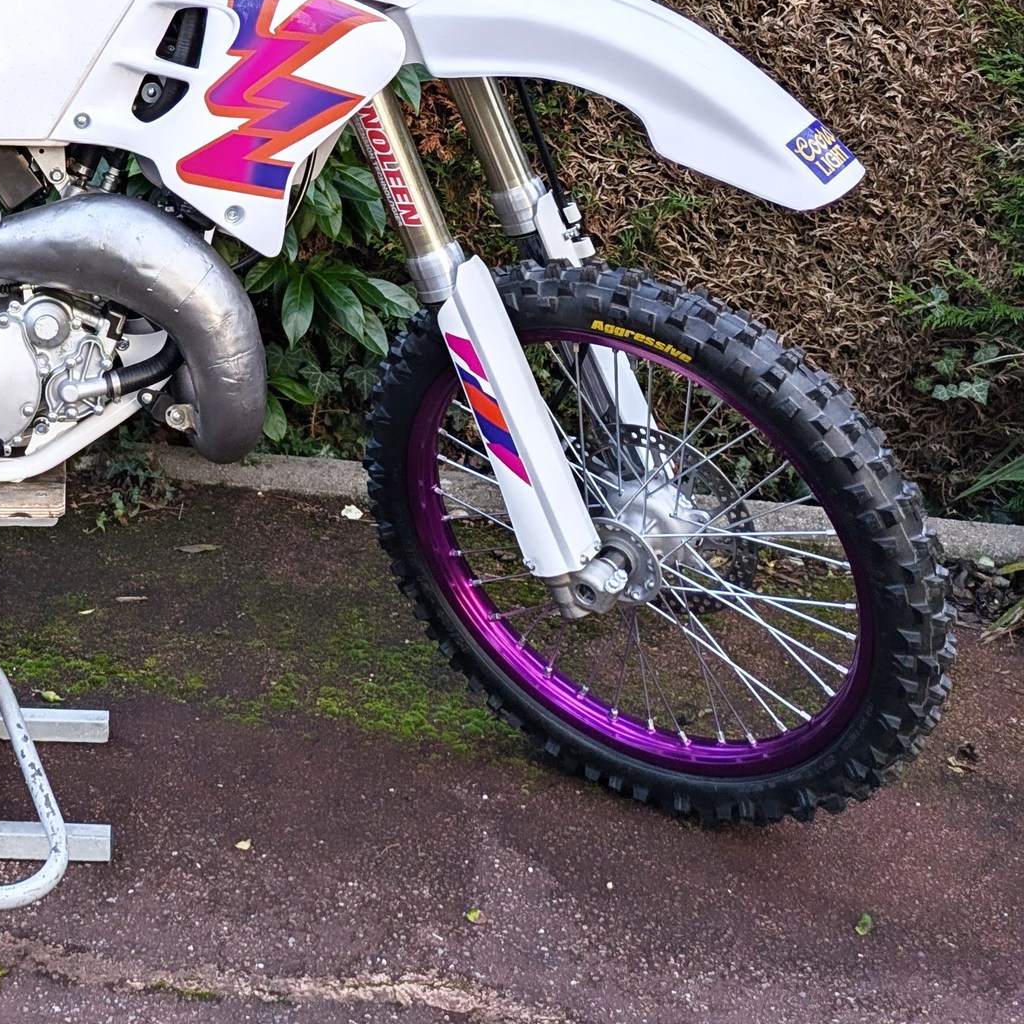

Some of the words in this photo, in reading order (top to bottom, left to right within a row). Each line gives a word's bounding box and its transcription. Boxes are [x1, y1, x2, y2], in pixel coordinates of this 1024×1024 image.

[358, 104, 424, 228] NOLEEN
[815, 143, 850, 177] LIGHT
[591, 319, 693, 363] Aggressive
